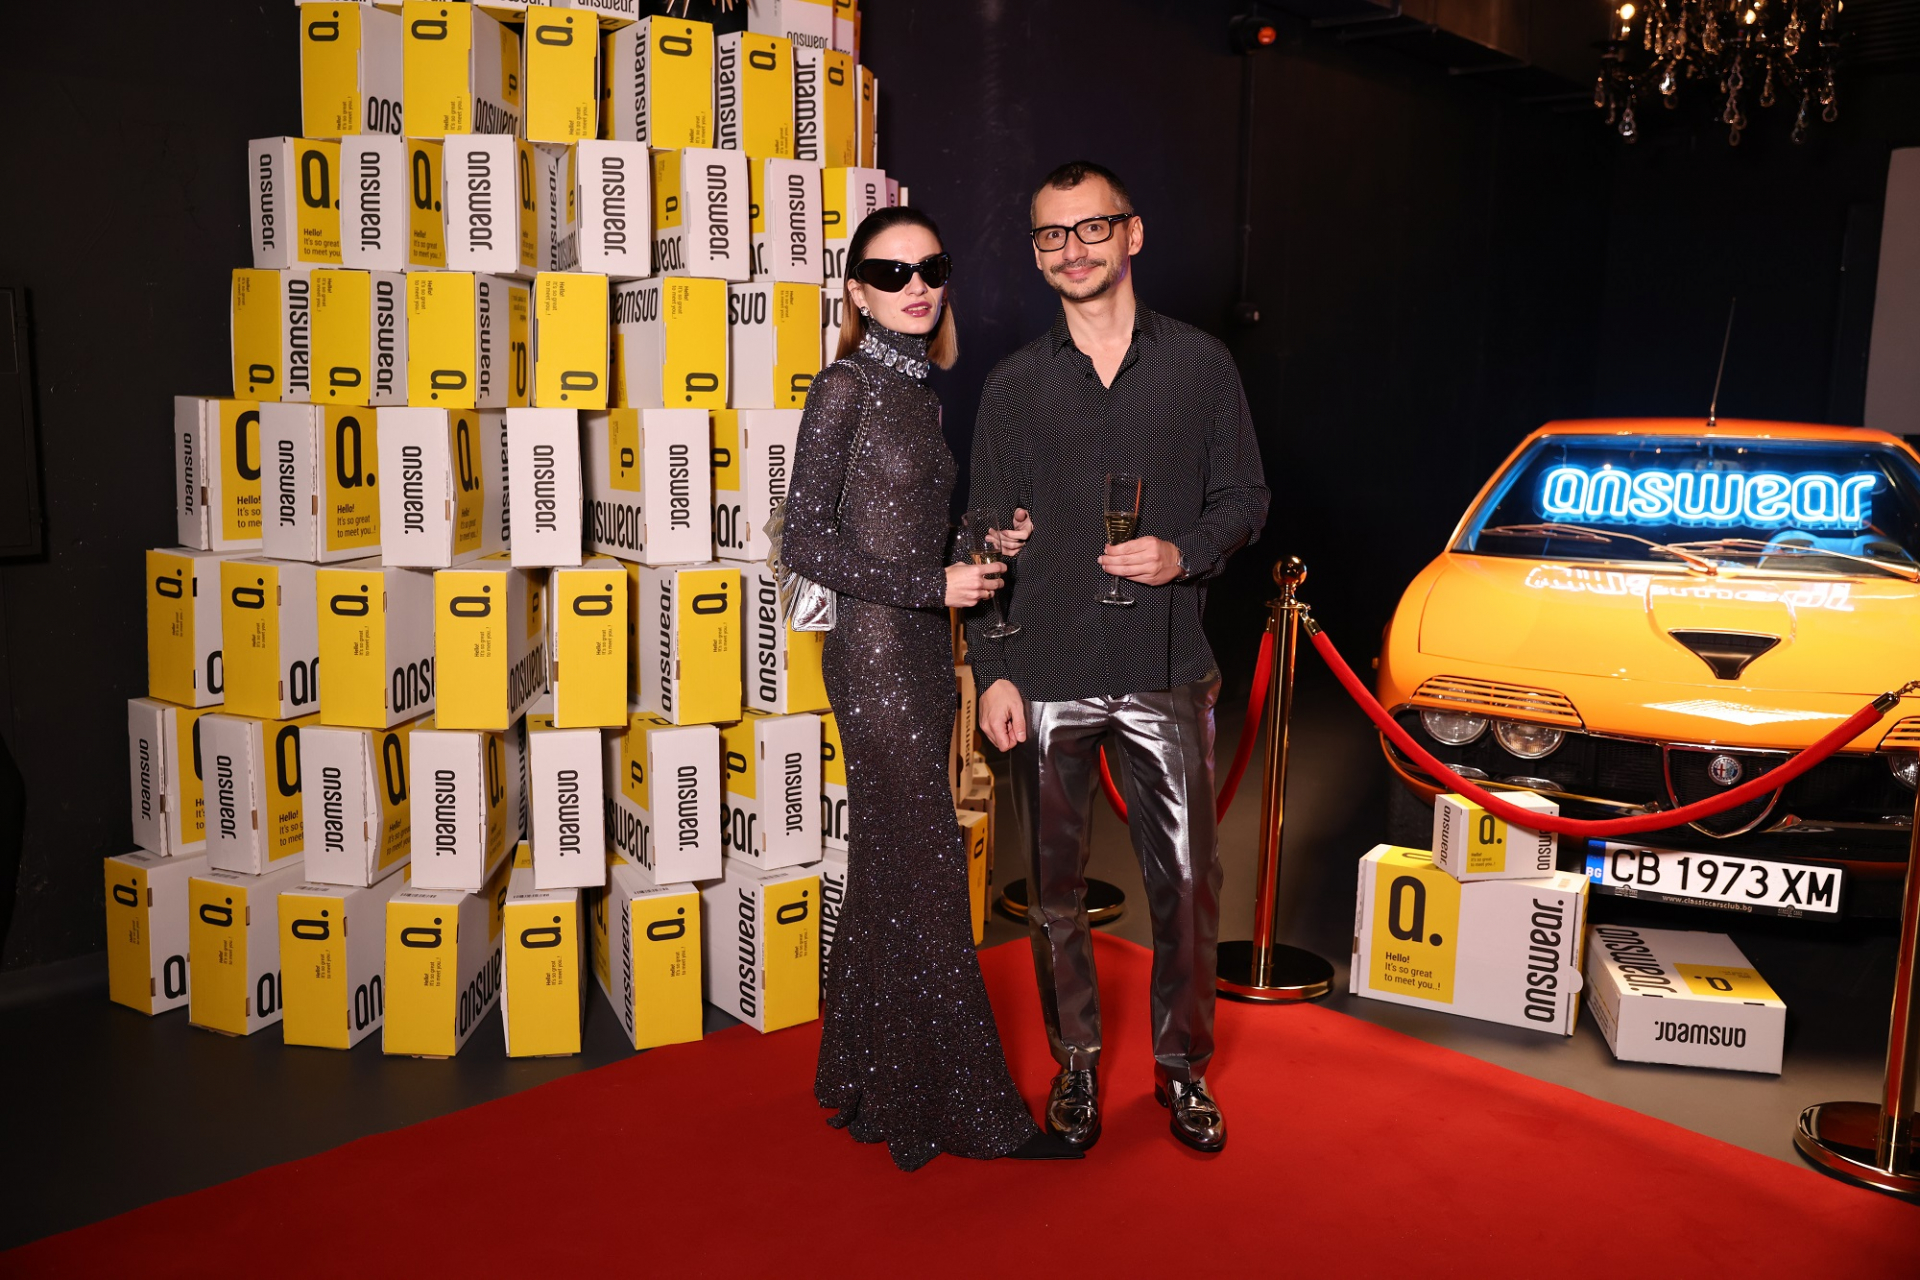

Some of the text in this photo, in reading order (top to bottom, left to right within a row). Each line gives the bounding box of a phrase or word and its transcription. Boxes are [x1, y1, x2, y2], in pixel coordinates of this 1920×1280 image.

[308, 10, 339, 42] a.
[411, 9, 448, 41] a.
[536, 16, 573, 46] a.
[659, 28, 693, 57] a.
[750, 43, 776, 71] a.
[634, 26, 647, 142] answear.
[828, 60, 844, 86] a.
[413, 150, 441, 212] a.
[521, 150, 535, 212] a.
[260, 154, 275, 251] answear.
[361, 151, 381, 251] answear.
[468, 151, 493, 252] answear.
[602, 156, 626, 256] answear.
[707, 164, 730, 261] answear.
[304, 228, 322, 237] Hello!
[788, 174, 807, 267] answear.
[304, 247, 311, 255] to
[312, 248, 328, 256] meet
[323, 240, 340, 249] great
[288, 279, 309, 394] answear.
[376, 280, 394, 397] answear.
[479, 282, 491, 399] answear.
[249, 364, 275, 394] a.
[329, 366, 362, 397] a.
[430, 369, 467, 400] a.
[560, 370, 599, 401] a.
[685, 372, 719, 402] a.
[336, 416, 375, 489] a.
[456, 418, 479, 492] a.
[183, 433, 194, 515] answear.
[278, 440, 295, 527] answear.
[402, 446, 424, 534] answear.
[533, 445, 557, 533] answear.
[669, 444, 690, 531] answear.
[237, 495, 261, 505] Hello!
[238, 507, 249, 516] It's
[337, 504, 355, 514] Hello!
[1542, 467, 1876, 523] answear
[238, 519, 246, 528] to
[337, 516, 346, 526] It's
[355, 515, 371, 526] great
[337, 530, 343, 538] to
[344, 528, 359, 537] meet
[155, 568, 182, 600] a.
[232, 578, 265, 610] a.
[330, 584, 369, 617] a.
[573, 583, 613, 617] a.
[692, 582, 728, 615] a.
[450, 585, 491, 618] a.
[660, 579, 672, 712] answear.
[139, 739, 151, 820] answear.
[488, 735, 504, 808] a.
[726, 751, 747, 780] a.
[217, 755, 236, 839] answear.
[322, 767, 344, 853] answear.
[677, 765, 699, 852] answear.
[785, 752, 803, 836] answear.
[279, 810, 299, 823] Hello!
[279, 823, 299, 835] It's so
[435, 770, 457, 857] answear.
[557, 770, 581, 857] answear.
[1479, 814, 1502, 845] a.
[280, 838, 287, 846] to
[1440, 805, 1451, 866] answear.
[1585, 866, 1602, 878] BG
[1611, 849, 1835, 908] CB 1973 XM
[113, 878, 138, 908] a.
[776, 890, 809, 925] a.
[1662, 895, 1753, 913] www.classiccarsclub.bg
[200, 897, 233, 928] a.
[291, 909, 330, 941] a.
[646, 907, 685, 942] a.
[1388, 875, 1443, 947] a.
[401, 917, 442, 949] a.
[520, 915, 562, 949] a.
[738, 888, 756, 1019] answear.
[1385, 952, 1410, 964] Hello!
[1524, 898, 1564, 1024] answear.
[1596, 927, 1677, 994] answear.
[1384, 973, 1393, 982] to
[1394, 974, 1416, 986] meet
[1385, 962, 1433, 979] It's so great
[1694, 975, 1734, 992] a.
[1655, 1020, 1747, 1048] answear.
